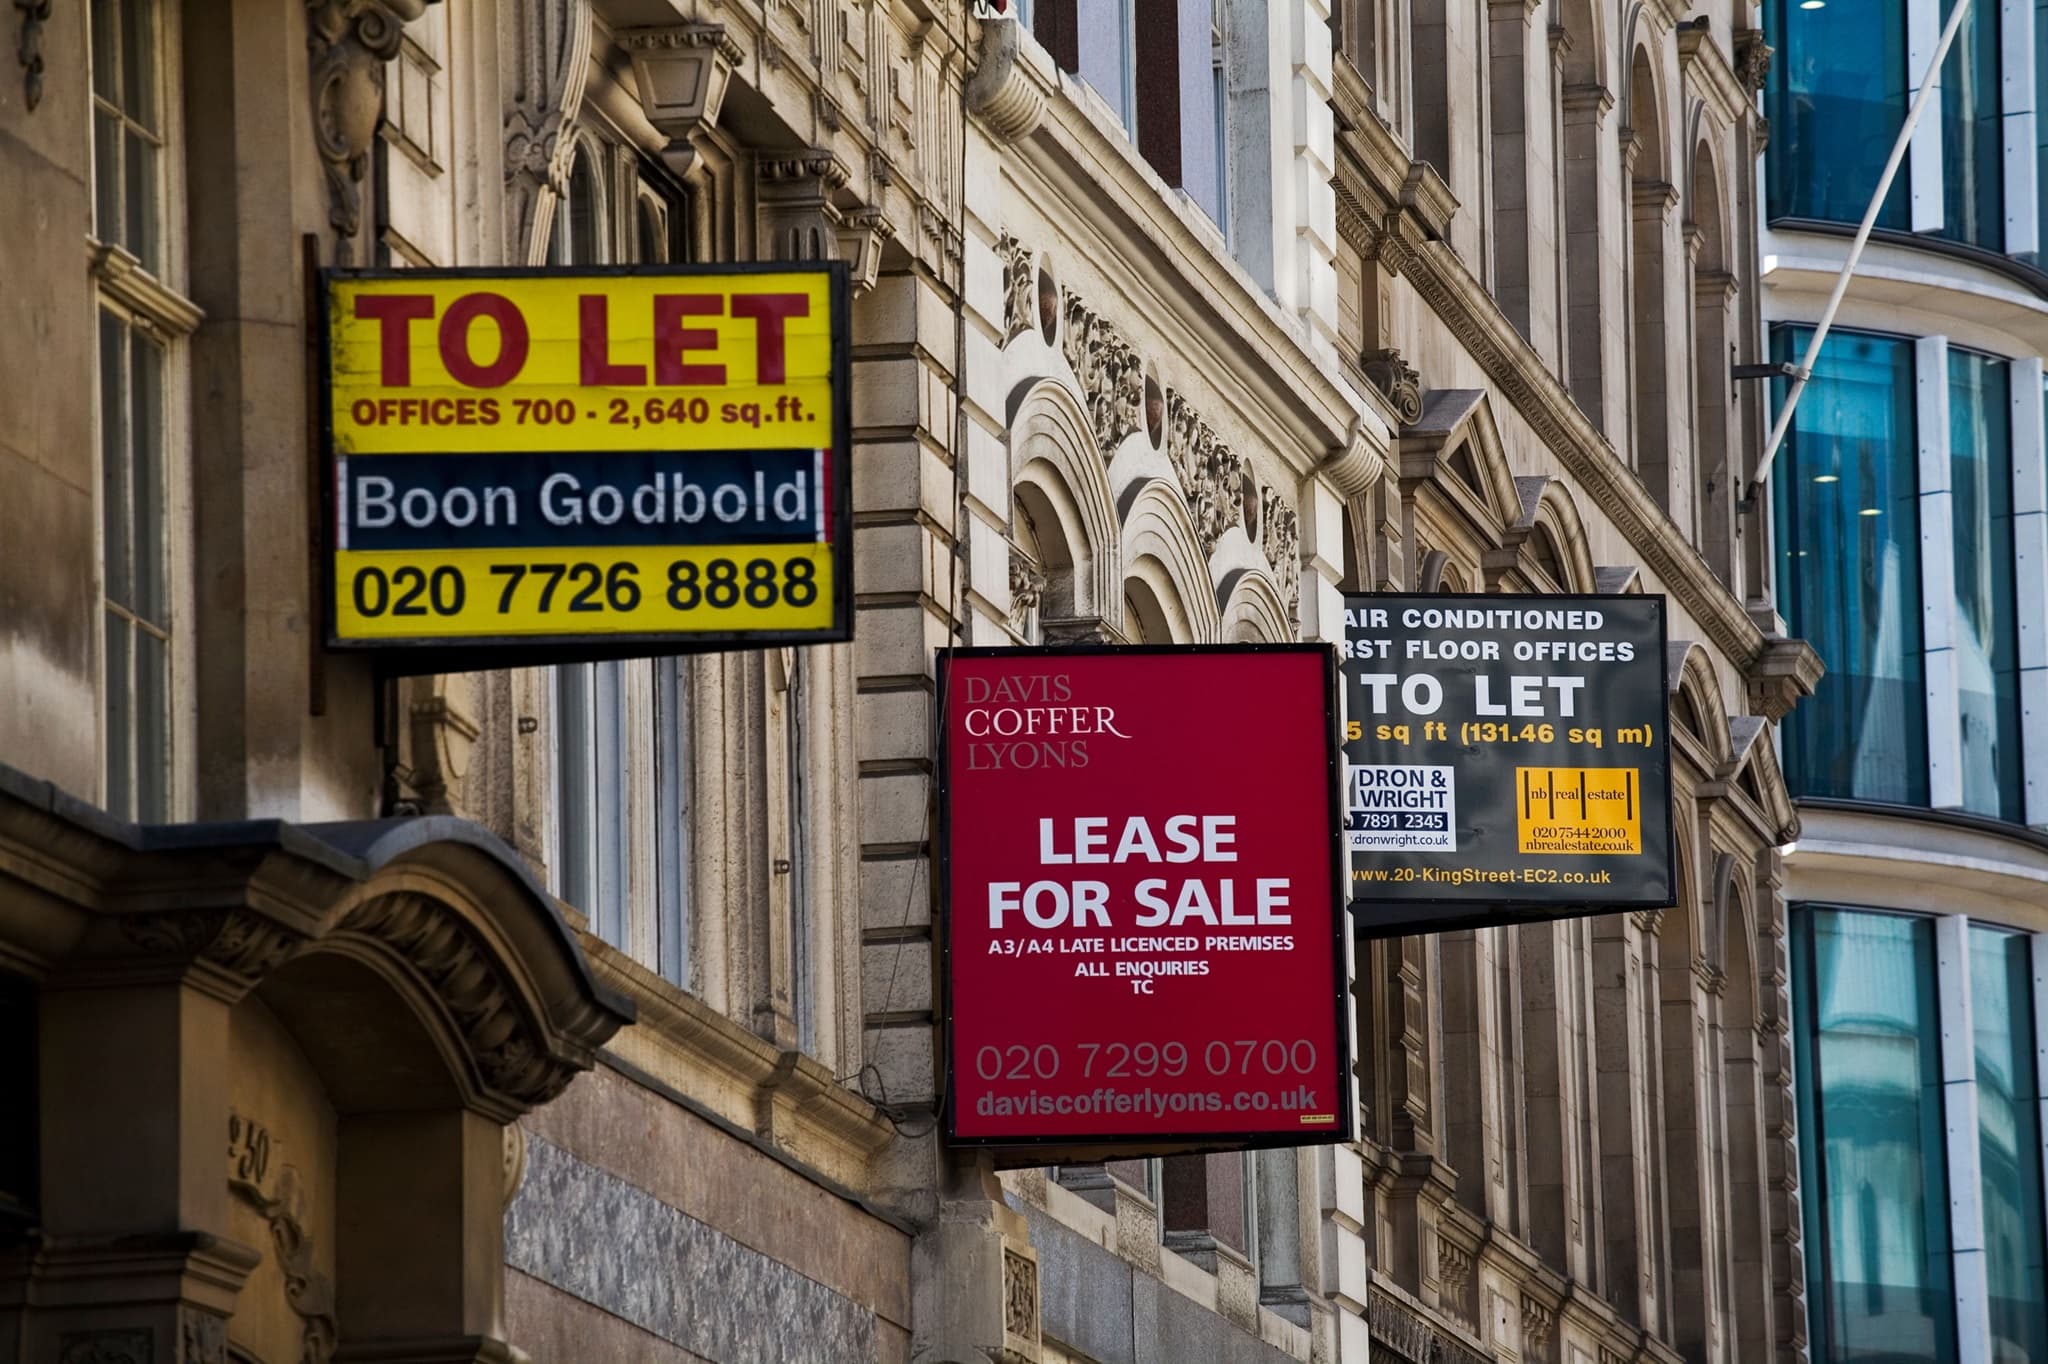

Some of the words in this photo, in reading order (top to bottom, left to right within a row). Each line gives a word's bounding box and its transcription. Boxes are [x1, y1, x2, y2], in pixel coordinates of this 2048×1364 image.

[354, 292, 529, 388] TO
[579, 293, 809, 387] LET
[350, 398, 500, 426] OFFICES
[512, 399, 575, 425] 700
[609, 398, 709, 429] 2,640
[721, 395, 815, 428] sq.ft.
[357, 476, 516, 527] Boon
[541, 470, 806, 524] Godbold
[353, 565, 465, 617] 020
[490, 562, 641, 613] 7726
[667, 557, 817, 611] 8888
[1344, 609, 1388, 628] AIR
[1403, 609, 1603, 629] CONDITIONED
[1407, 640, 1499, 660] FLOOR
[1514, 641, 1634, 661] OFFICES
[965, 675, 1071, 703] DAVIS
[1361, 674, 1443, 715] TO
[1475, 675, 1584, 716] LET
[965, 707, 1131, 738] COFFER
[1377, 725, 1409, 745] sq
[1424, 721, 1446, 740] ft
[1461, 723, 1554, 745] (131.46
[1569, 729, 1602, 748] sq
[1618, 724, 1652, 747] m)
[968, 740, 1088, 769] LYONS
[1359, 769, 1424, 787] DRON
[1431, 770, 1446, 787] &
[1360, 790, 1447, 808] WRIGHT
[1532, 788, 1547, 799] nb
[1556, 788, 1578, 800] real
[1588, 790, 1624, 800] estate
[1362, 814, 1397, 828] 7891
[1405, 815, 1443, 828] 2345
[1533, 827, 1557, 838] 020
[1559, 828, 1591, 838] 7544
[1592, 828, 1626, 838] 2000
[1040, 815, 1237, 864] LEASE
[1351, 834, 1448, 847] .dronwright.co.uk
[1526, 837, 1633, 851] nbrealestate.co.uk
[989, 881, 1112, 928] FOR
[1135, 878, 1291, 927] SALE
[988, 939, 1054, 957] A3/A4
[1060, 938, 1104, 952] LATE
[1111, 937, 1199, 952] LICENCED
[1206, 936, 1294, 950] PREMISES
[1075, 962, 1110, 976] ALL
[1116, 961, 1209, 978] ENQUIRIES
[1131, 980, 1153, 994] TC
[977, 1044, 1059, 1080] 020
[1078, 1042, 1187, 1077] 7299
[1205, 1040, 1316, 1075] 0700
[977, 1085, 1317, 1117] daviscofferlyons.co.uk
